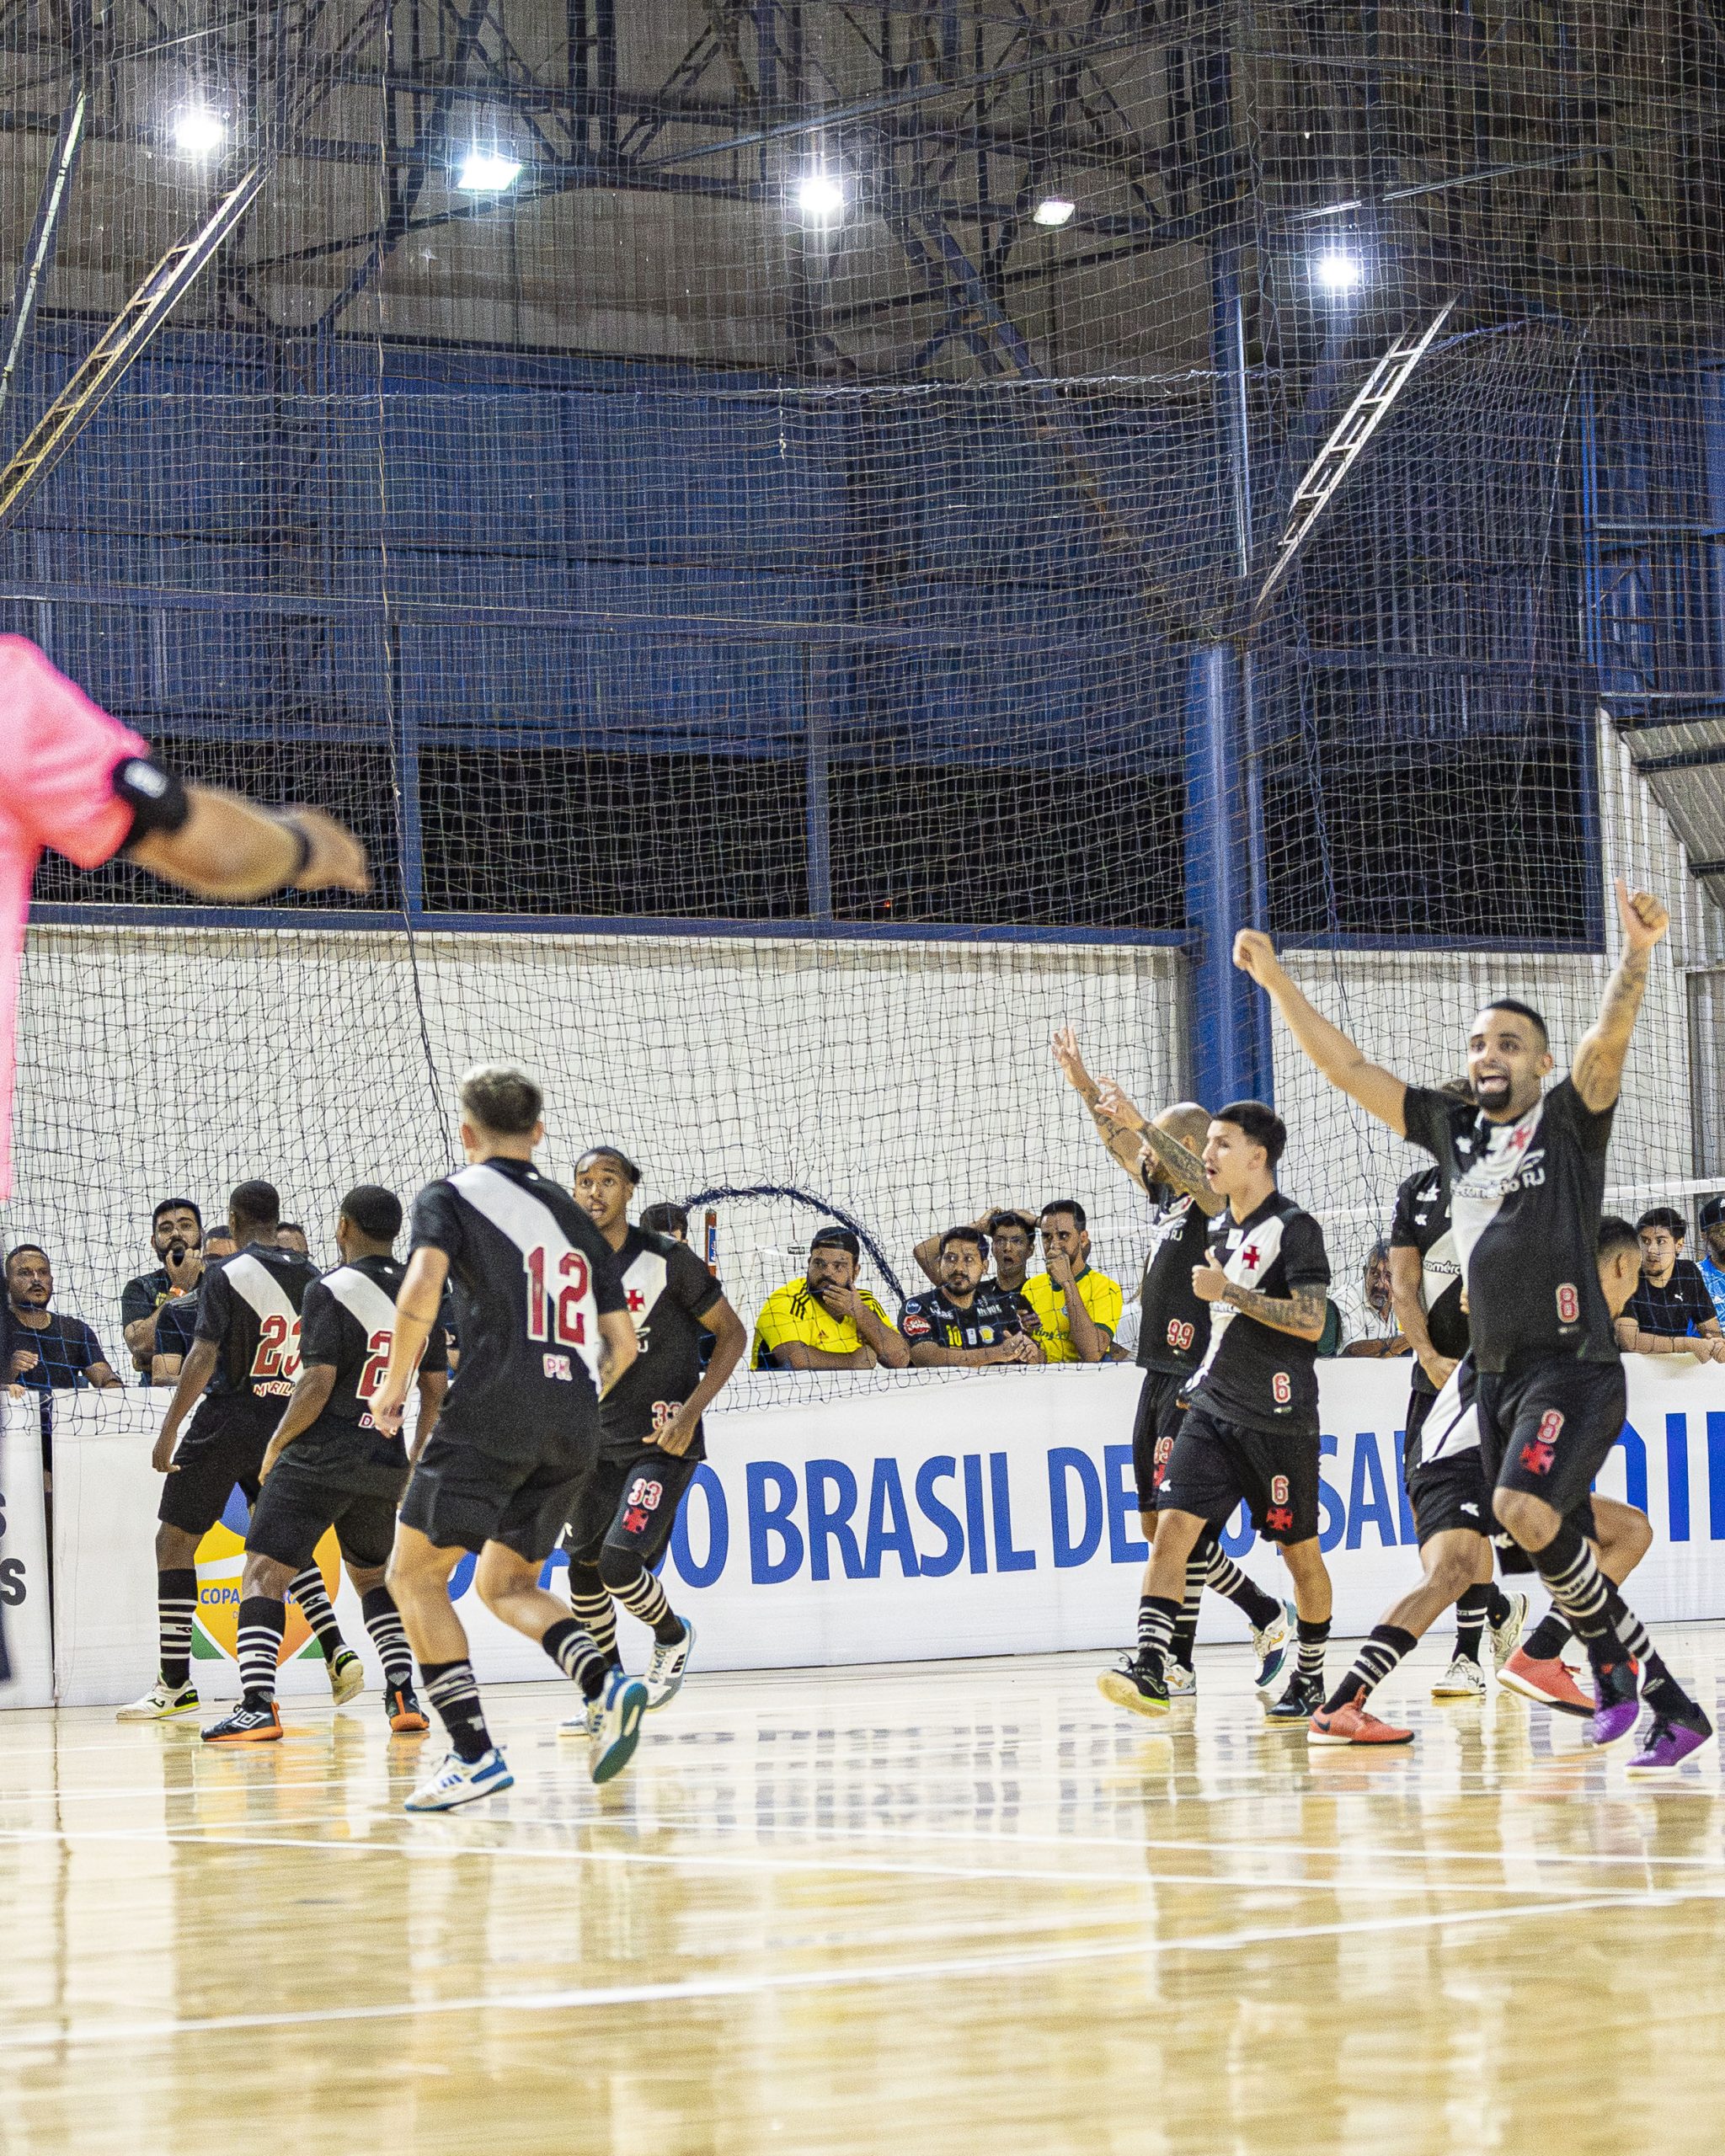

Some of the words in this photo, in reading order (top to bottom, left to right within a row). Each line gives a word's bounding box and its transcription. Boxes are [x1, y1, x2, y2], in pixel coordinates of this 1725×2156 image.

[523, 1245, 594, 1349] 12
[1556, 1283, 1579, 1323] 8
[1167, 1318, 1195, 1349] 99
[1272, 1371, 1292, 1403] 6
[1537, 1409, 1564, 1444] 8
[628, 1478, 663, 1510] 33
[1271, 1475, 1290, 1505] 6
[745, 1449, 1034, 1585] BRASIL
[1047, 1443, 1150, 1572] DE
[200, 1588, 241, 1604] COPA
